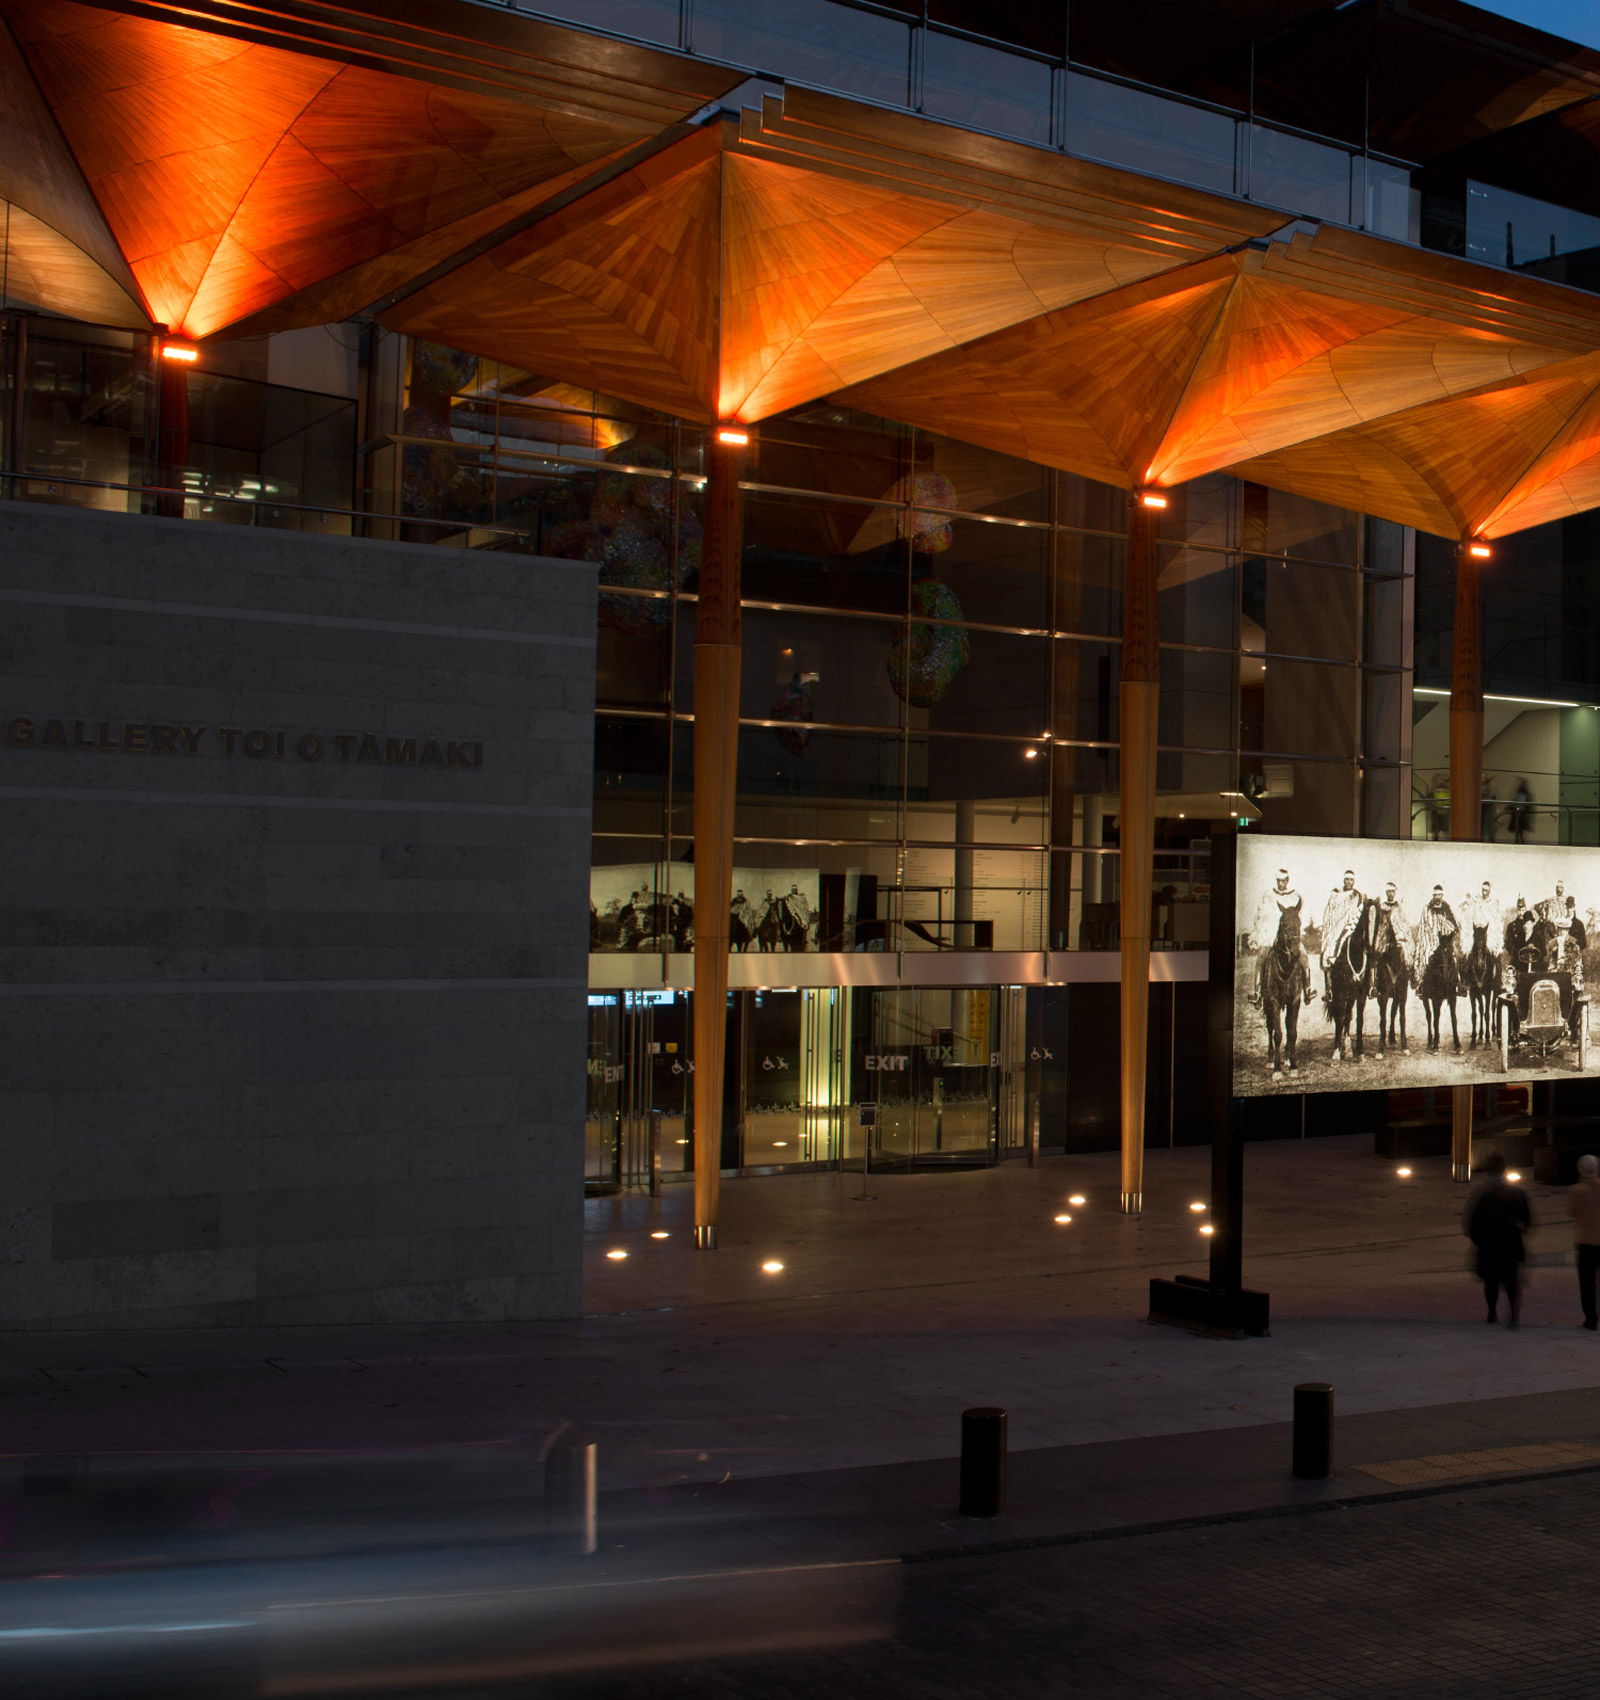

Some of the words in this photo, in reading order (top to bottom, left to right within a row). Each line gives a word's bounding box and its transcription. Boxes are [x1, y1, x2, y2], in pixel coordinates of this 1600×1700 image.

[5, 717, 207, 755] GALLERY
[217, 728, 285, 760] TOI
[297, 733, 324, 761] O
[864, 1055, 909, 1071] EXIT
